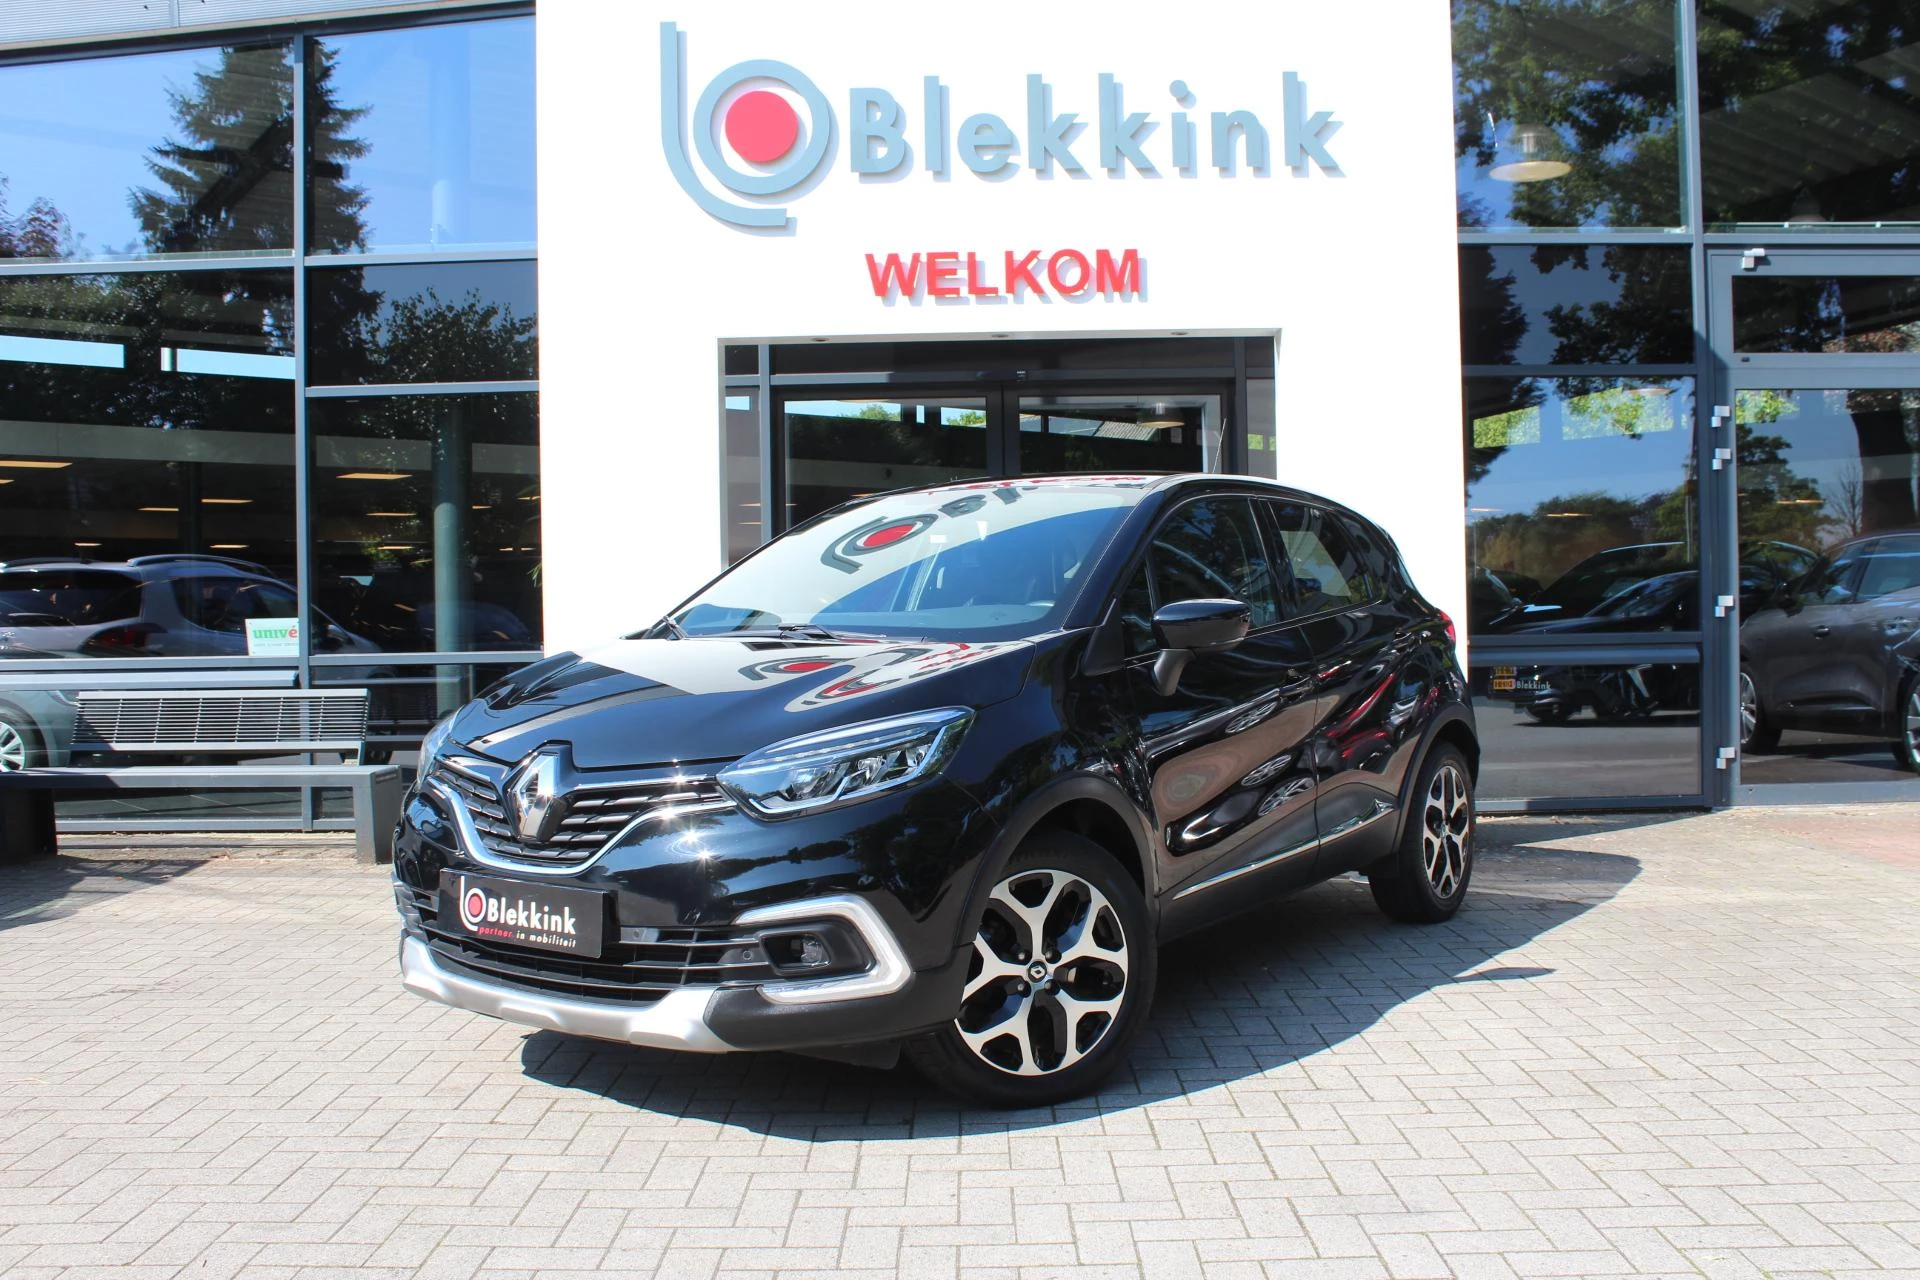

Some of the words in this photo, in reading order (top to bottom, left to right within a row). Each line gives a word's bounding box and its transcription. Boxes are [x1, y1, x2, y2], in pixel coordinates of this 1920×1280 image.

[849, 71, 1340, 175] Blekkink
[864, 248, 1143, 298] WELKOM
[478, 926, 514, 939] partner
[516, 930, 526, 940] in
[529, 933, 577, 948] mobiliteit
[486, 896, 577, 935] Blekkink
